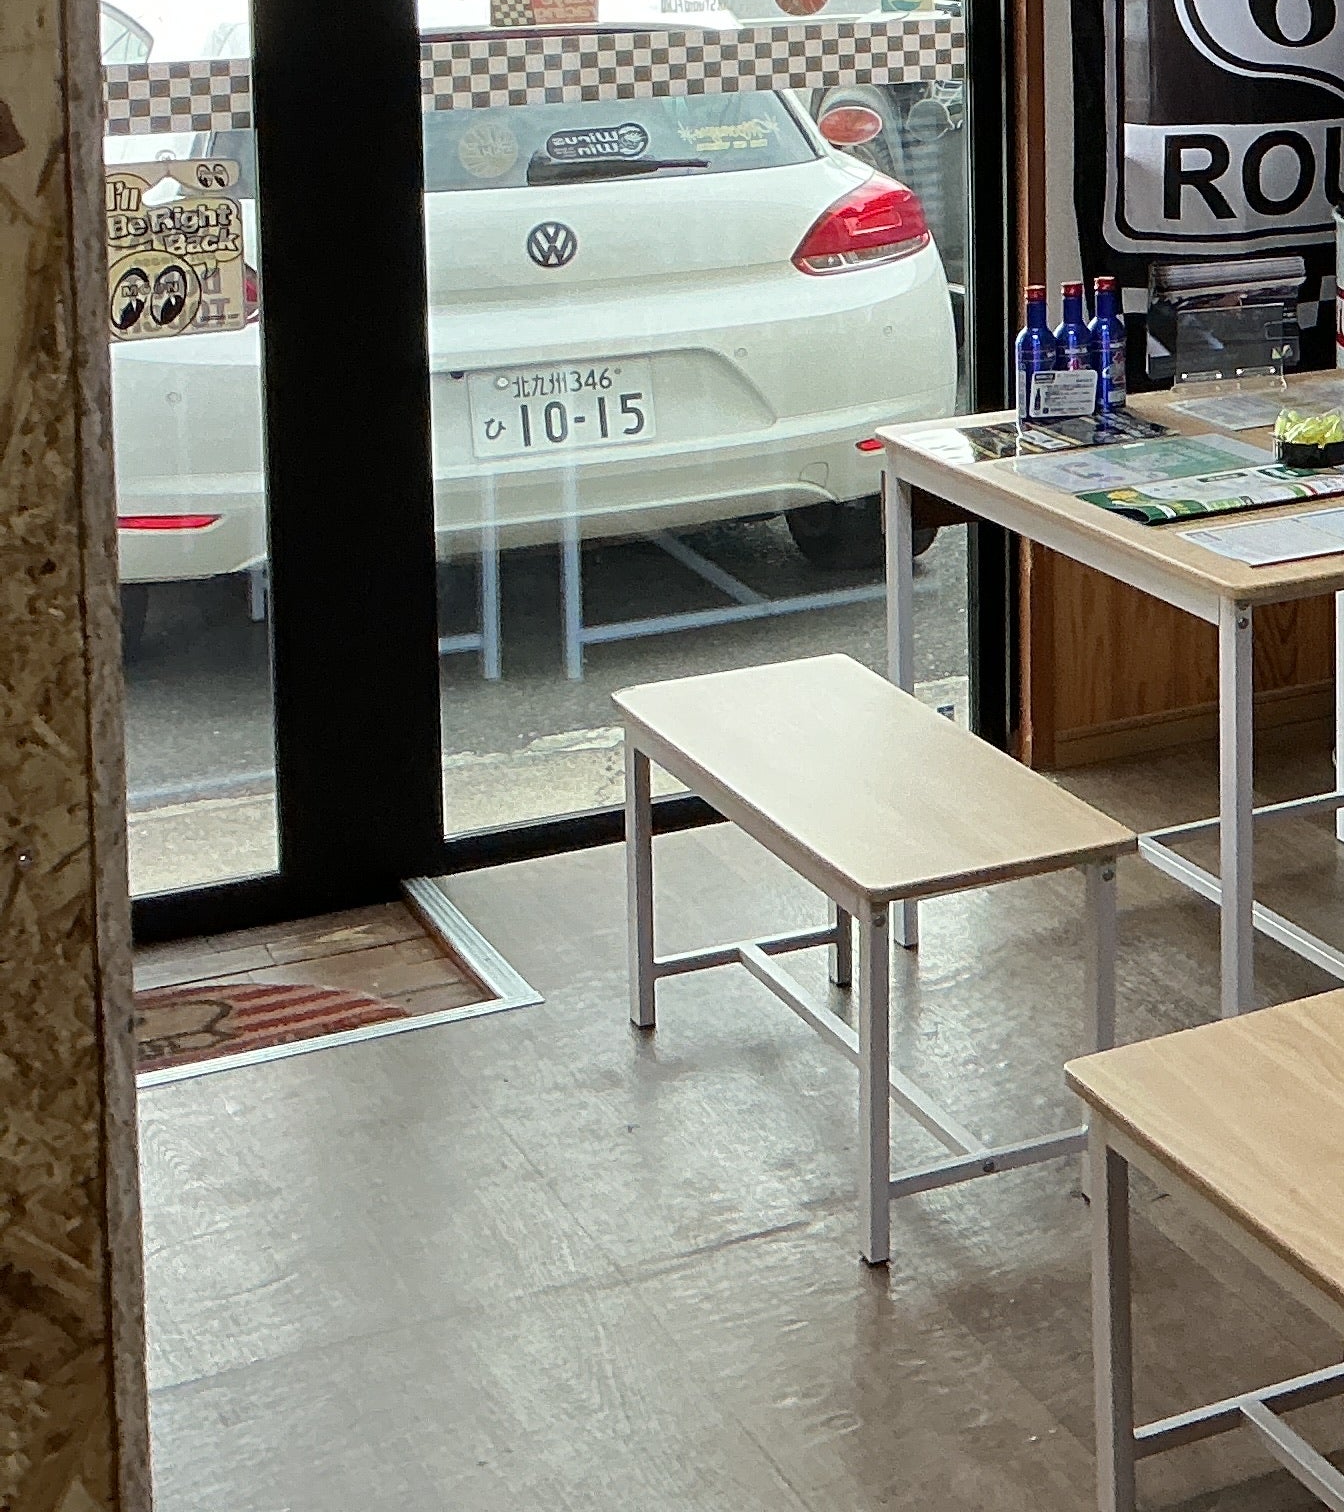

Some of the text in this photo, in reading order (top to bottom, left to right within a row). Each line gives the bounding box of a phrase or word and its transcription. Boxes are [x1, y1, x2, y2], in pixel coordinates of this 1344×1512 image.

[106, 203, 233, 240] Be Right
[164, 227, 239, 257] Back
[484, 417, 507, 440] ひ
[520, 392, 646, 448] 10-15
